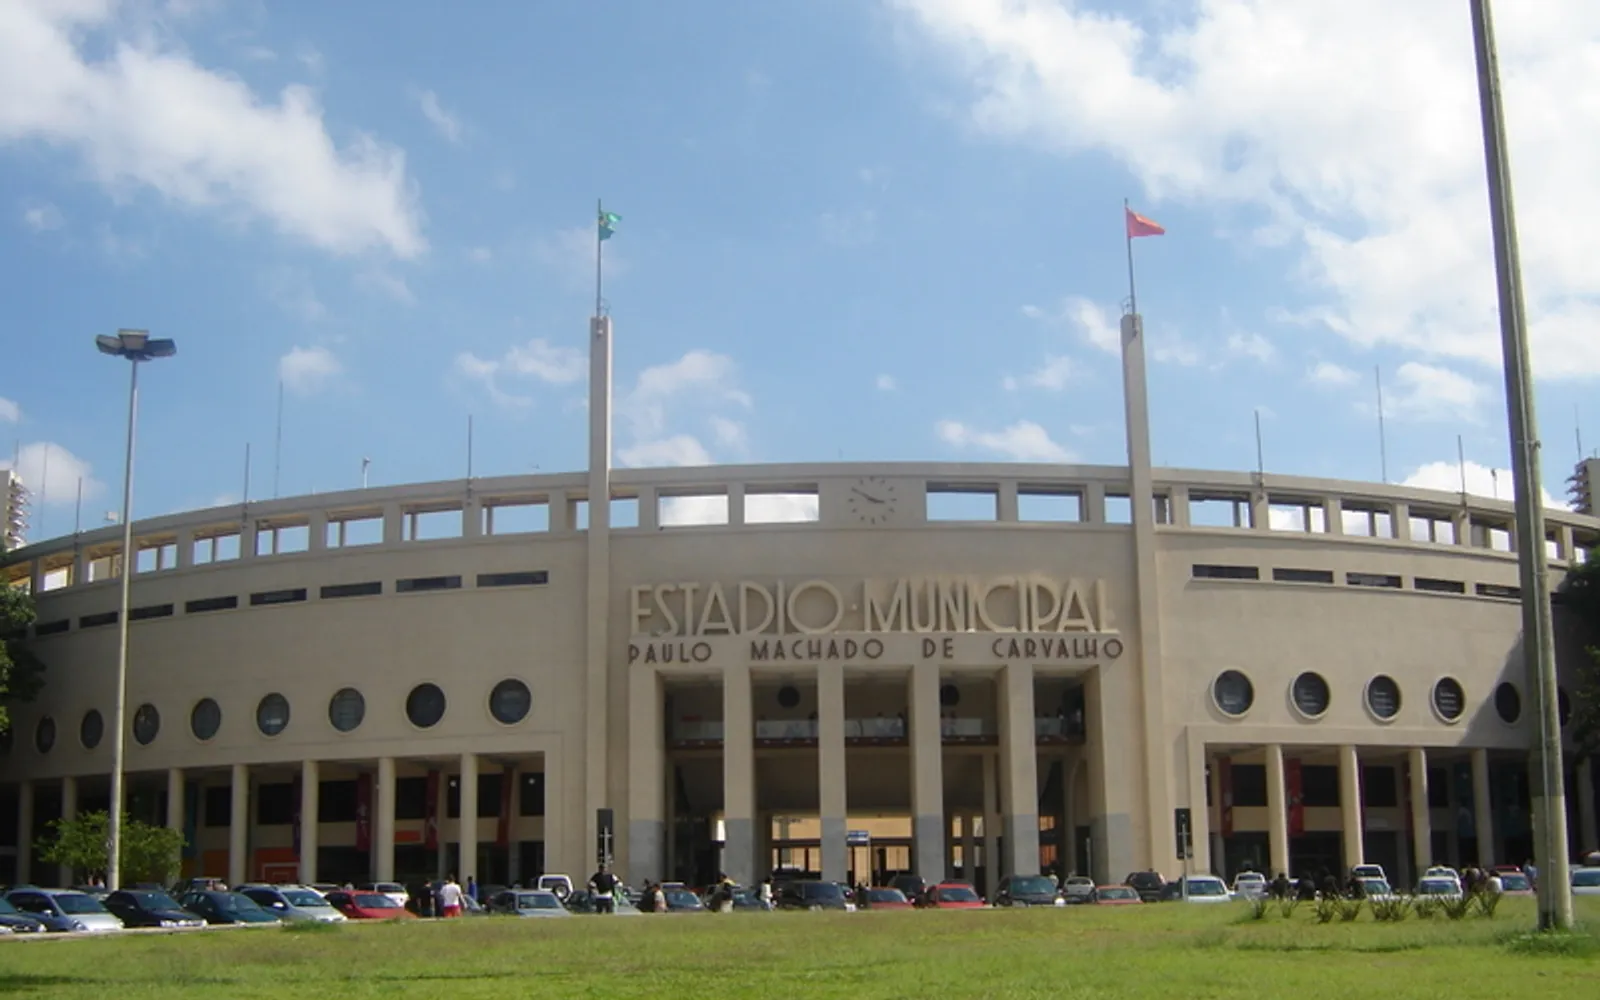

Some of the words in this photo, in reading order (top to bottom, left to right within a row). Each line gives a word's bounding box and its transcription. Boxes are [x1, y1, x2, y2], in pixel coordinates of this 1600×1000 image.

[630, 579, 844, 637] ESTADIO
[863, 576, 1121, 634] MUNICIPAL
[628, 641, 712, 664] PAULO
[750, 638, 884, 661] MACHADO
[922, 638, 954, 659] DE
[991, 638, 1124, 659] CARVALHO
